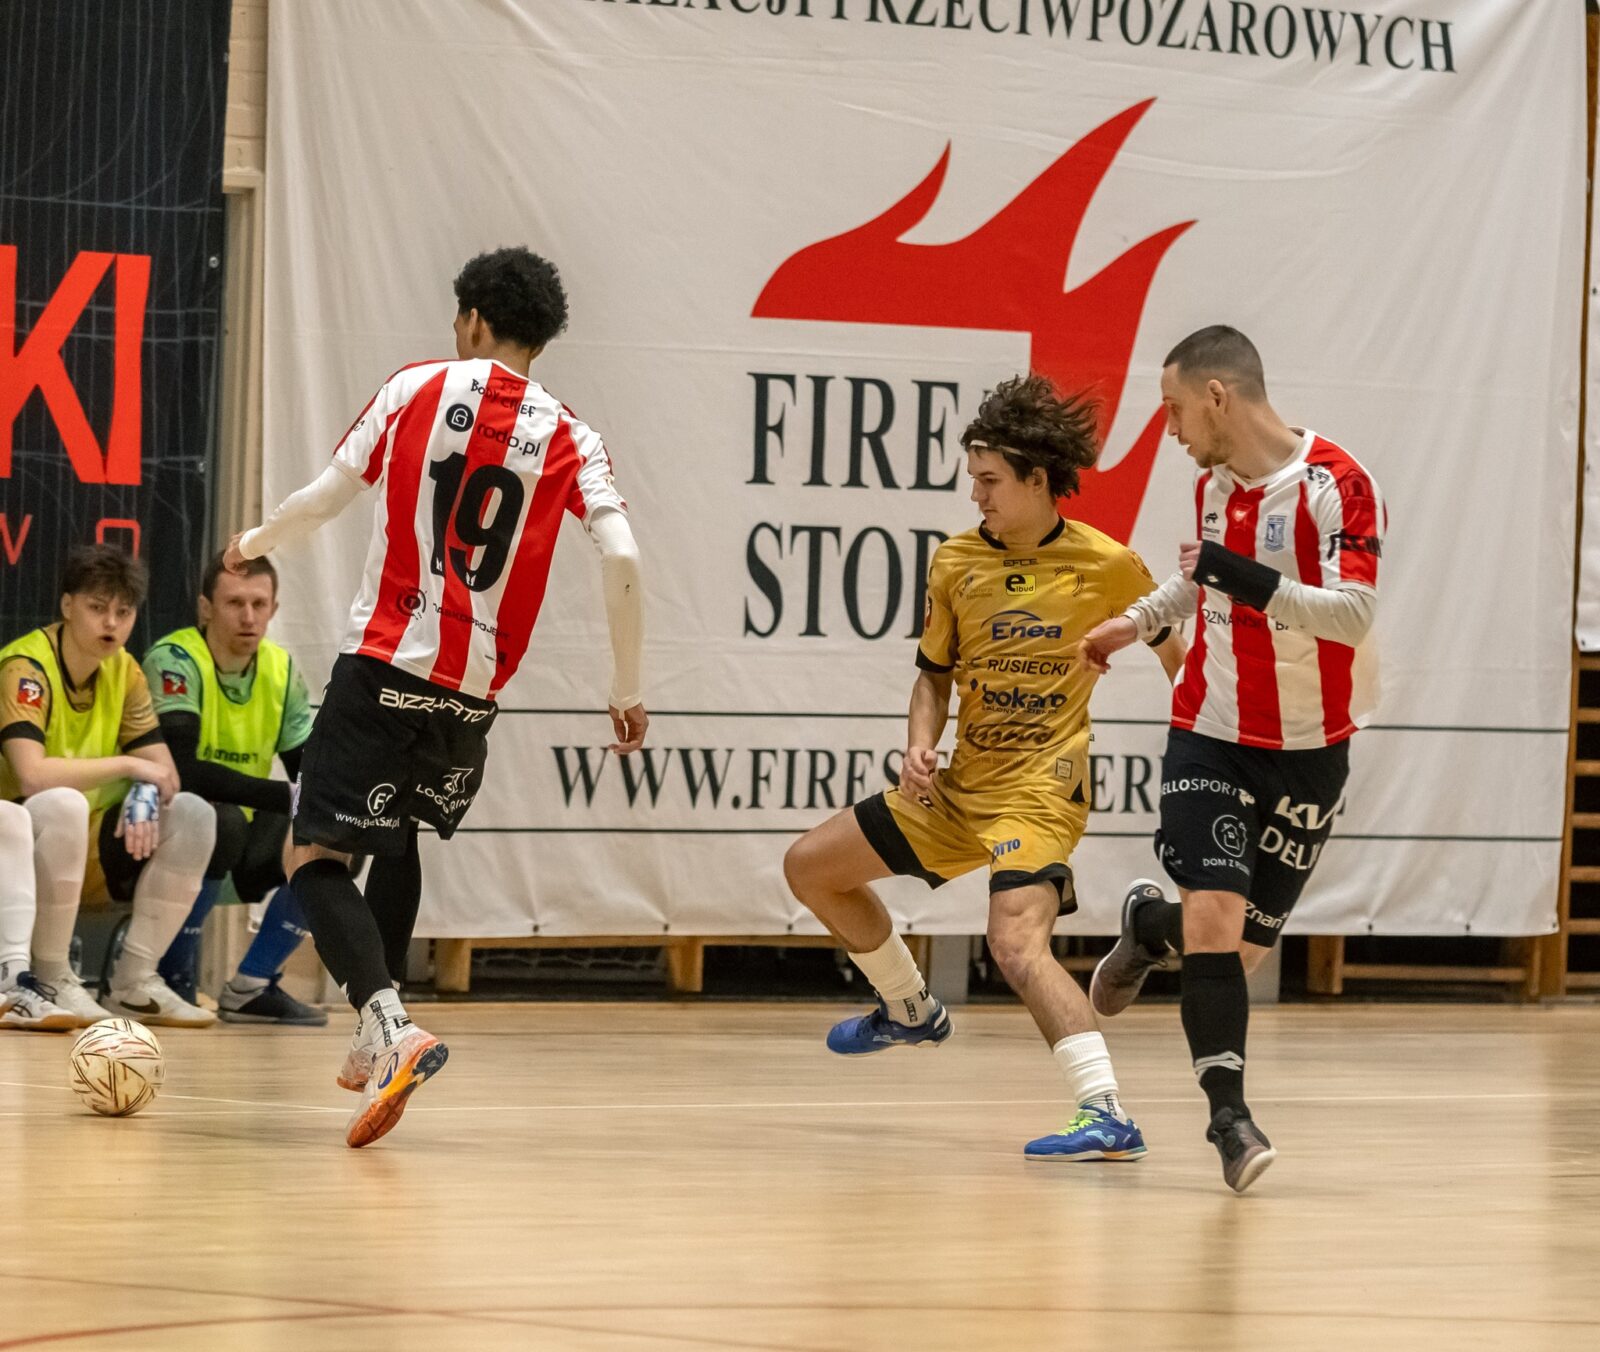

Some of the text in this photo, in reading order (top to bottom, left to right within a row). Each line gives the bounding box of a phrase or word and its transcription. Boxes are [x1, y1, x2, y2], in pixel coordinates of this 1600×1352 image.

[477, 423, 541, 457] rodo.pl
[745, 372, 961, 492] FIRE
[430, 451, 524, 593] 19
[992, 621, 1062, 640] Enea
[988, 659, 1070, 676] RUSIECKI
